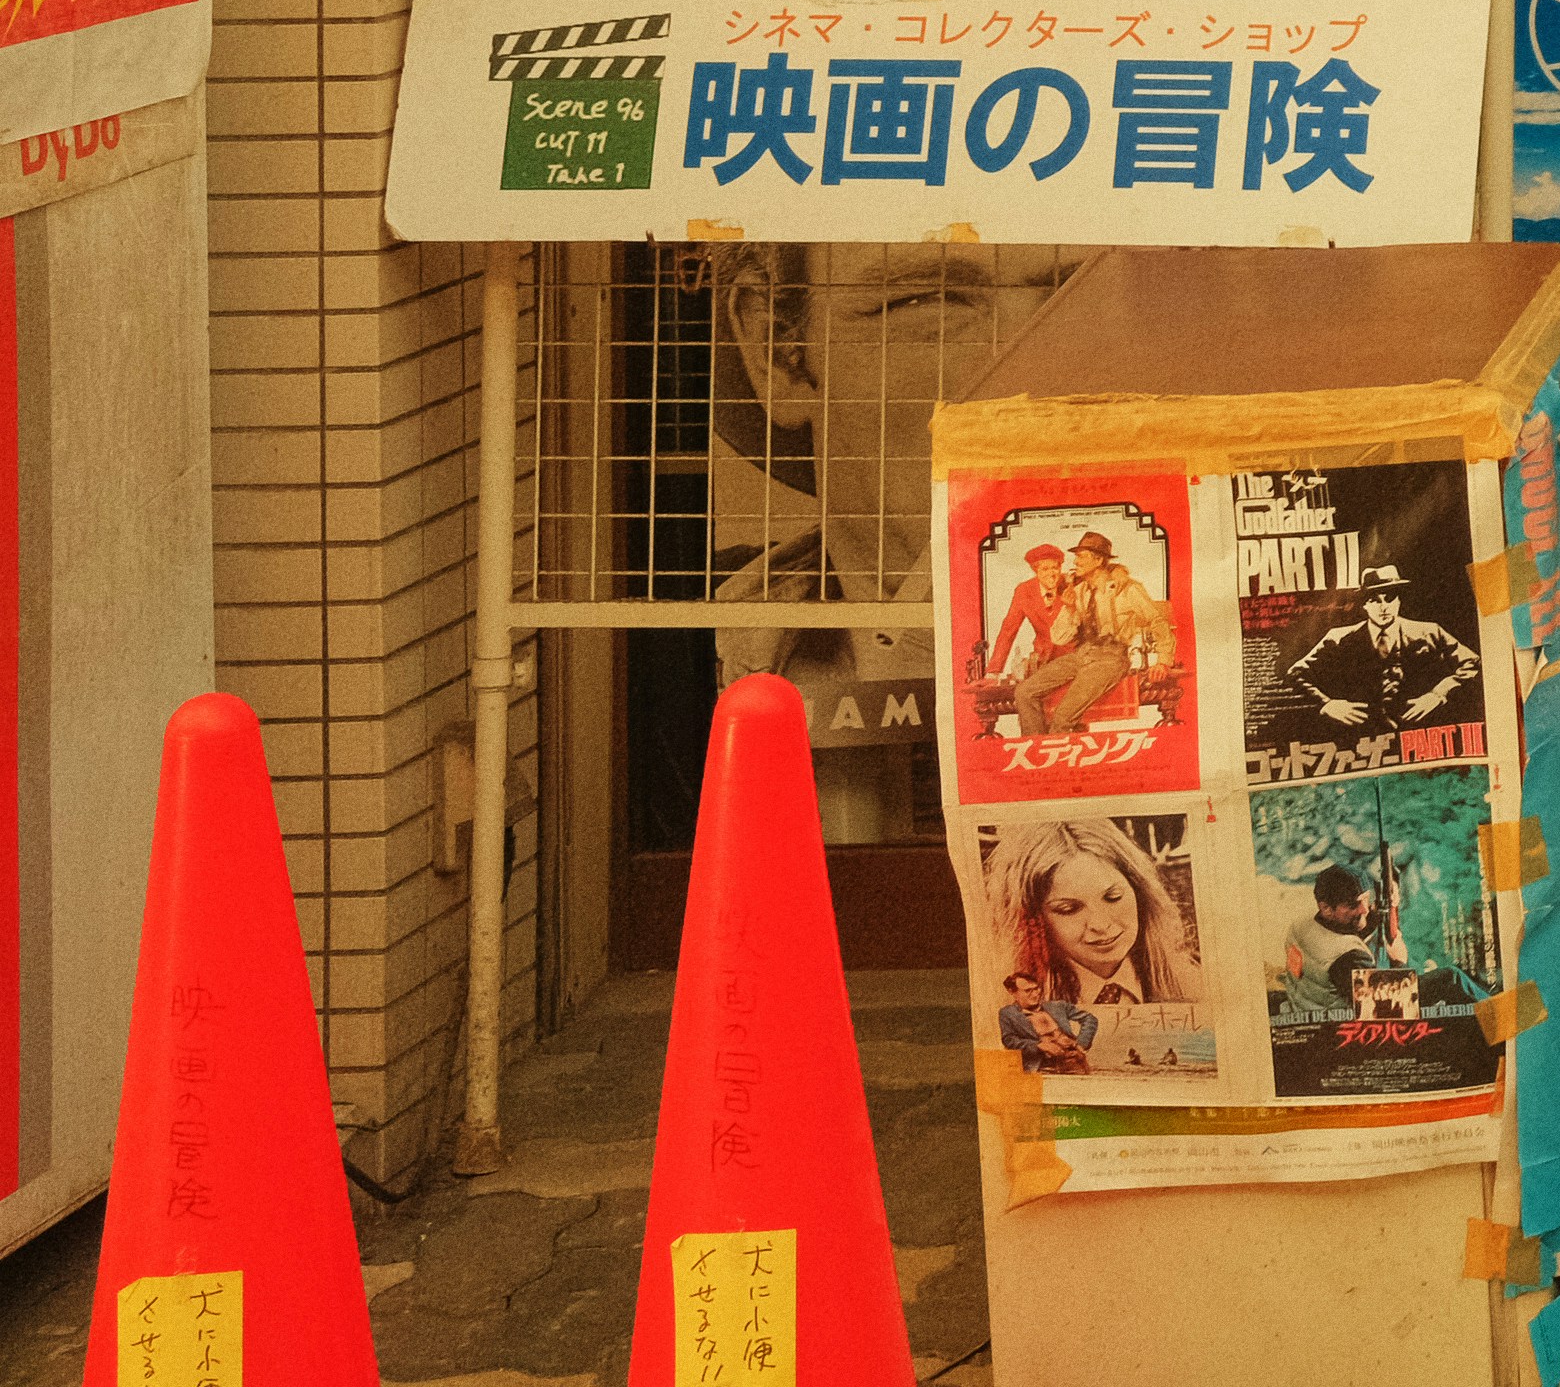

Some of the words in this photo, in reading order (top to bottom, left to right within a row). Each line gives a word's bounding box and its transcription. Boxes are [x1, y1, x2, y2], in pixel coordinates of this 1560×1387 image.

[724, 8, 1369, 51] シネマ・コレクターズ・ショップ
[523, 92, 608, 123] Scene
[615, 98, 645, 121] 96
[683, 53, 1380, 194] 映画の冒険
[586, 132, 608, 154] 11
[547, 162, 607, 185] Take
[614, 163, 625, 184] 1
[1238, 473, 1275, 499] The
[1235, 497, 1336, 536] Godfather
[1238, 537, 1330, 597] PART
[1333, 531, 1361, 590] II
[1002, 730, 1157, 772] スティング
[1246, 733, 1400, 784] ゴッドファーザー
[1401, 726, 1456, 765] PART
